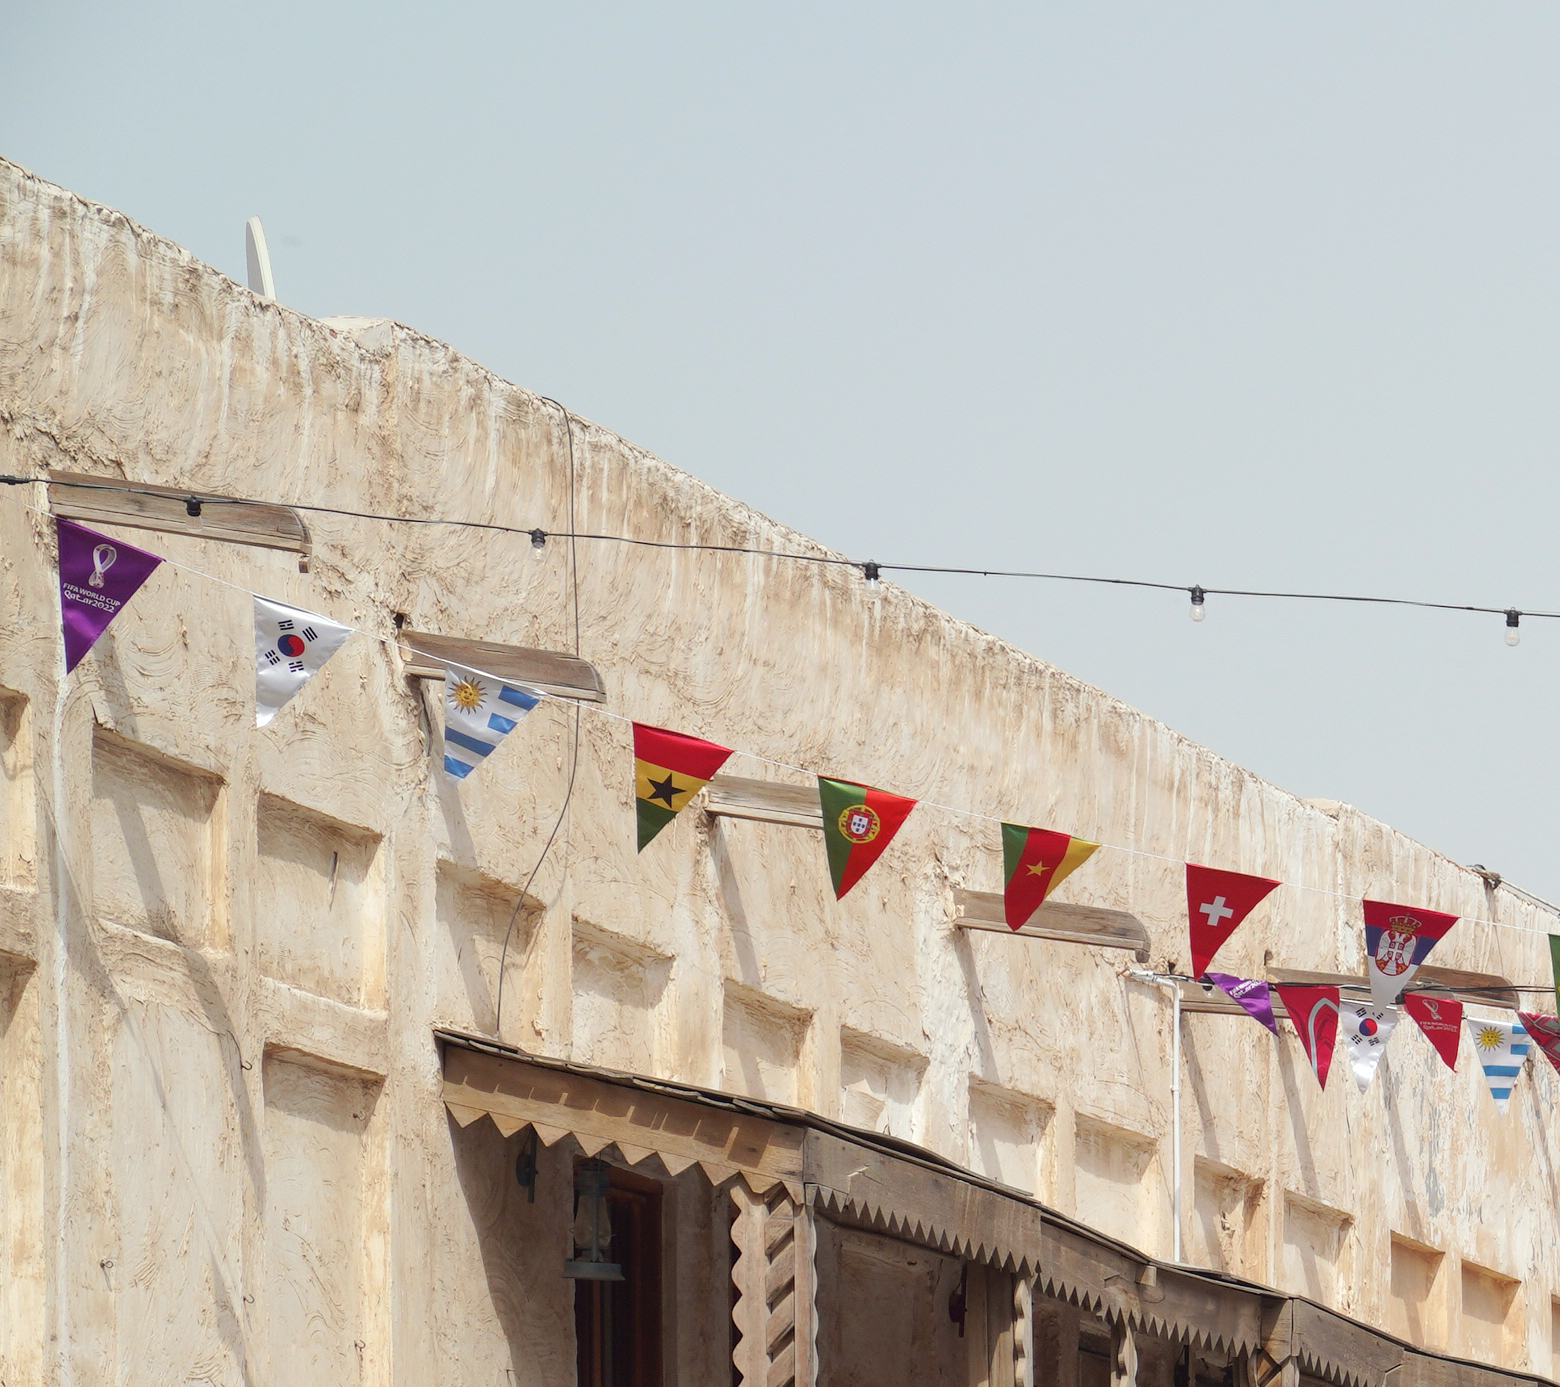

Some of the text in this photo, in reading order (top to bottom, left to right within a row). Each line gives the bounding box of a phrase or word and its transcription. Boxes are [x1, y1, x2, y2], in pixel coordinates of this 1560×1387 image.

[63, 582, 121, 607] FIFA WORLD CUP
